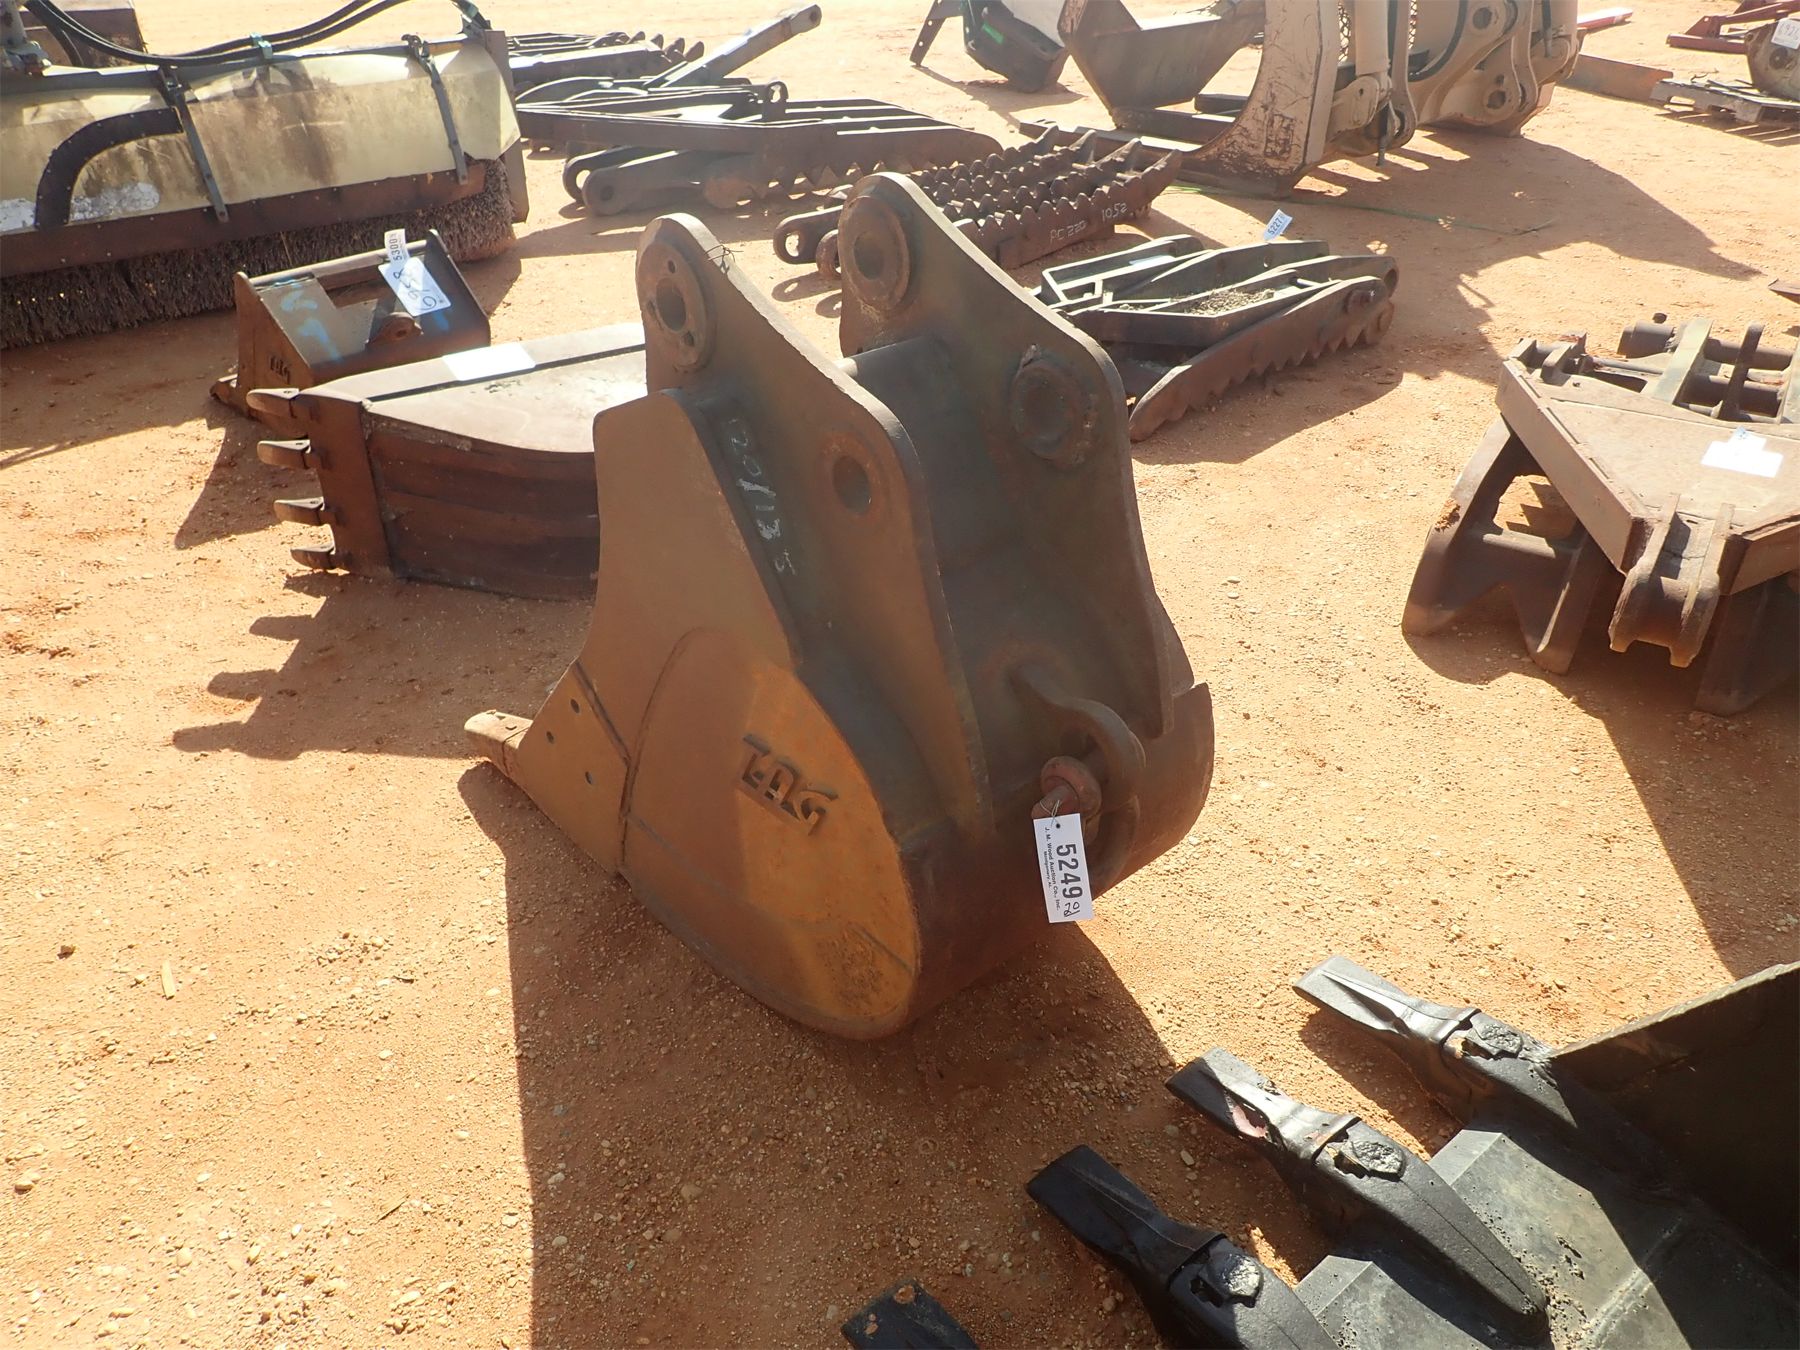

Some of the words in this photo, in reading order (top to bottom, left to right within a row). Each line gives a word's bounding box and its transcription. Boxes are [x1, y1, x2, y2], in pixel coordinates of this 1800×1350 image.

[1102, 202, 1128, 221] 1052
[1267, 217, 1283, 235] 5227
[389, 238, 403, 261] 5300
[1056, 843, 1083, 899] 5249
